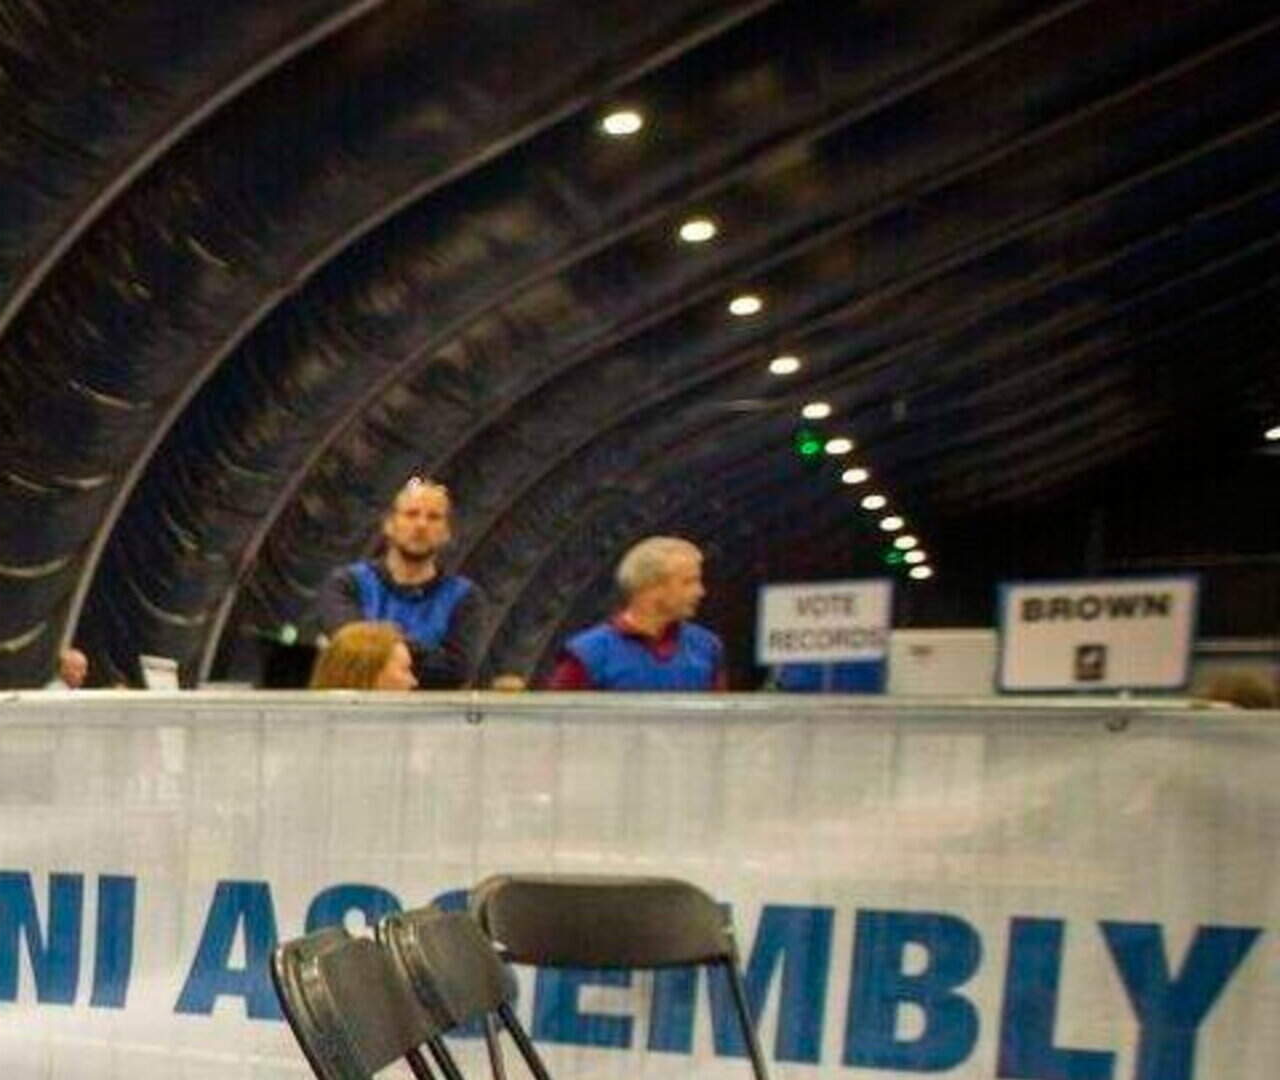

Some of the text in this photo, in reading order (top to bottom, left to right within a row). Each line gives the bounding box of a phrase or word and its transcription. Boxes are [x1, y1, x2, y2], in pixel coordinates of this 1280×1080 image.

[796, 593, 855, 618] VOTE
[1022, 594, 1173, 622] BROWN
[768, 625, 889, 651] RECORDS
